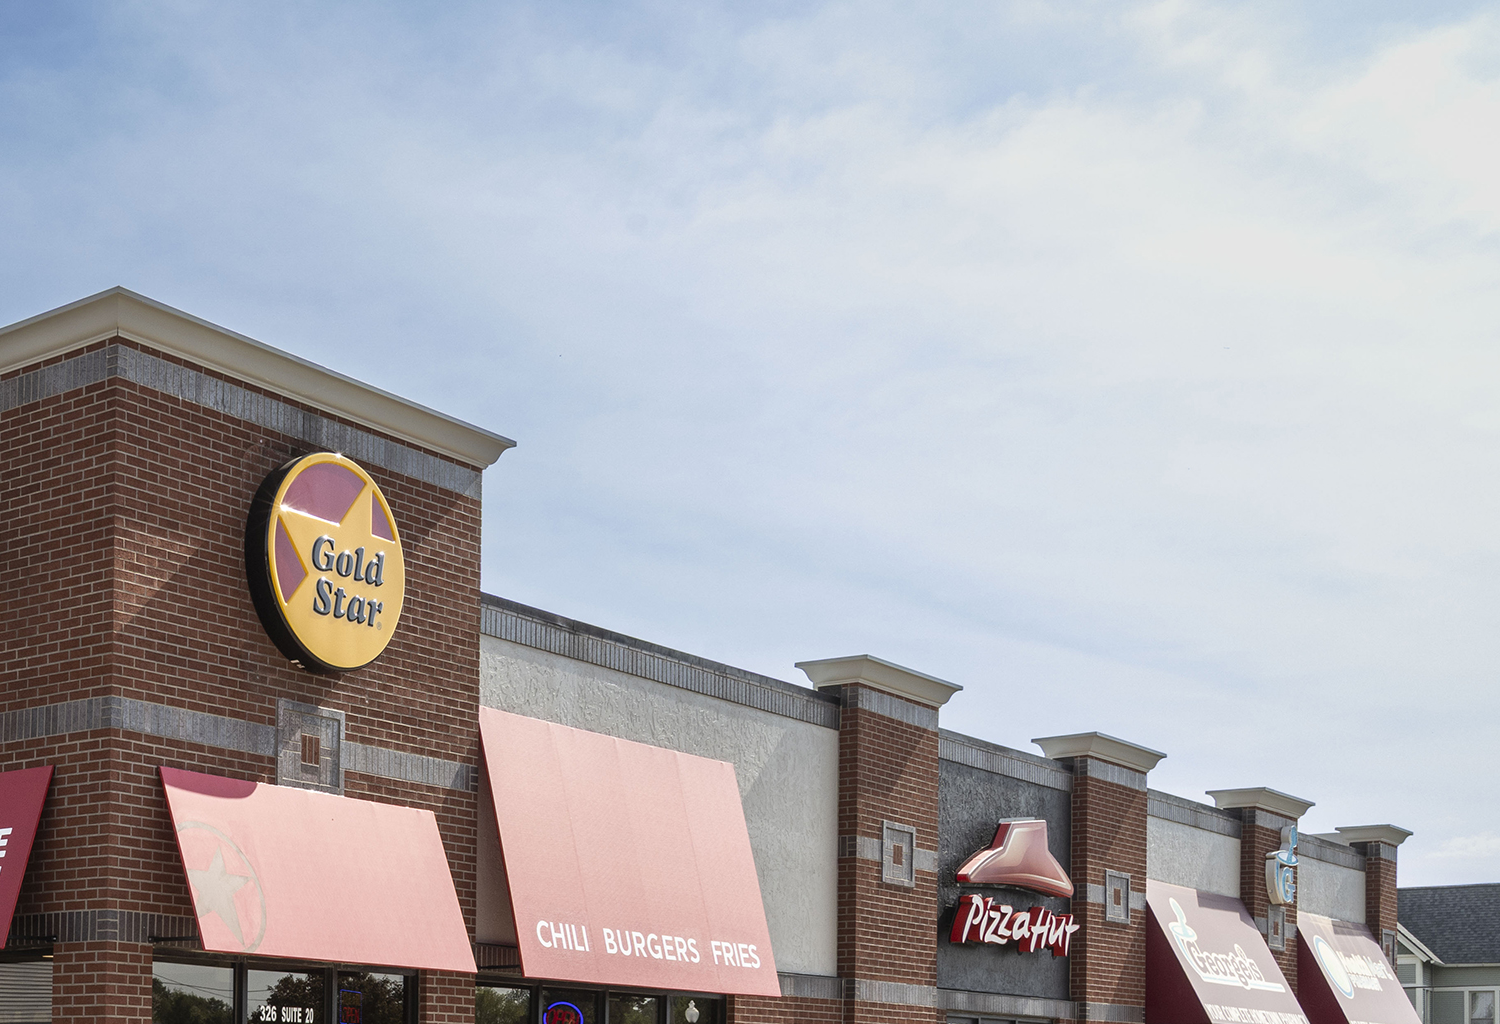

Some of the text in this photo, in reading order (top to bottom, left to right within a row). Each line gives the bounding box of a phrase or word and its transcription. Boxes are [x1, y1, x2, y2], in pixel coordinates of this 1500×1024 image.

[312, 534, 385, 587] Gold
[313, 576, 384, 627] Star
[1282, 866, 1296, 904] G
[536, 920, 761, 969] CHILI BURGERS FRIES
[962, 893, 1080, 957] Pizza Hut
[1185, 940, 1266, 990] George's
[260, 1005, 314, 1024] 326 SUITE 20
[342, 1006, 360, 1024] OPEN
[1203, 1003, 1226, 1020] YOUR
[1219, 1005, 1255, 1024] COMPLETE
